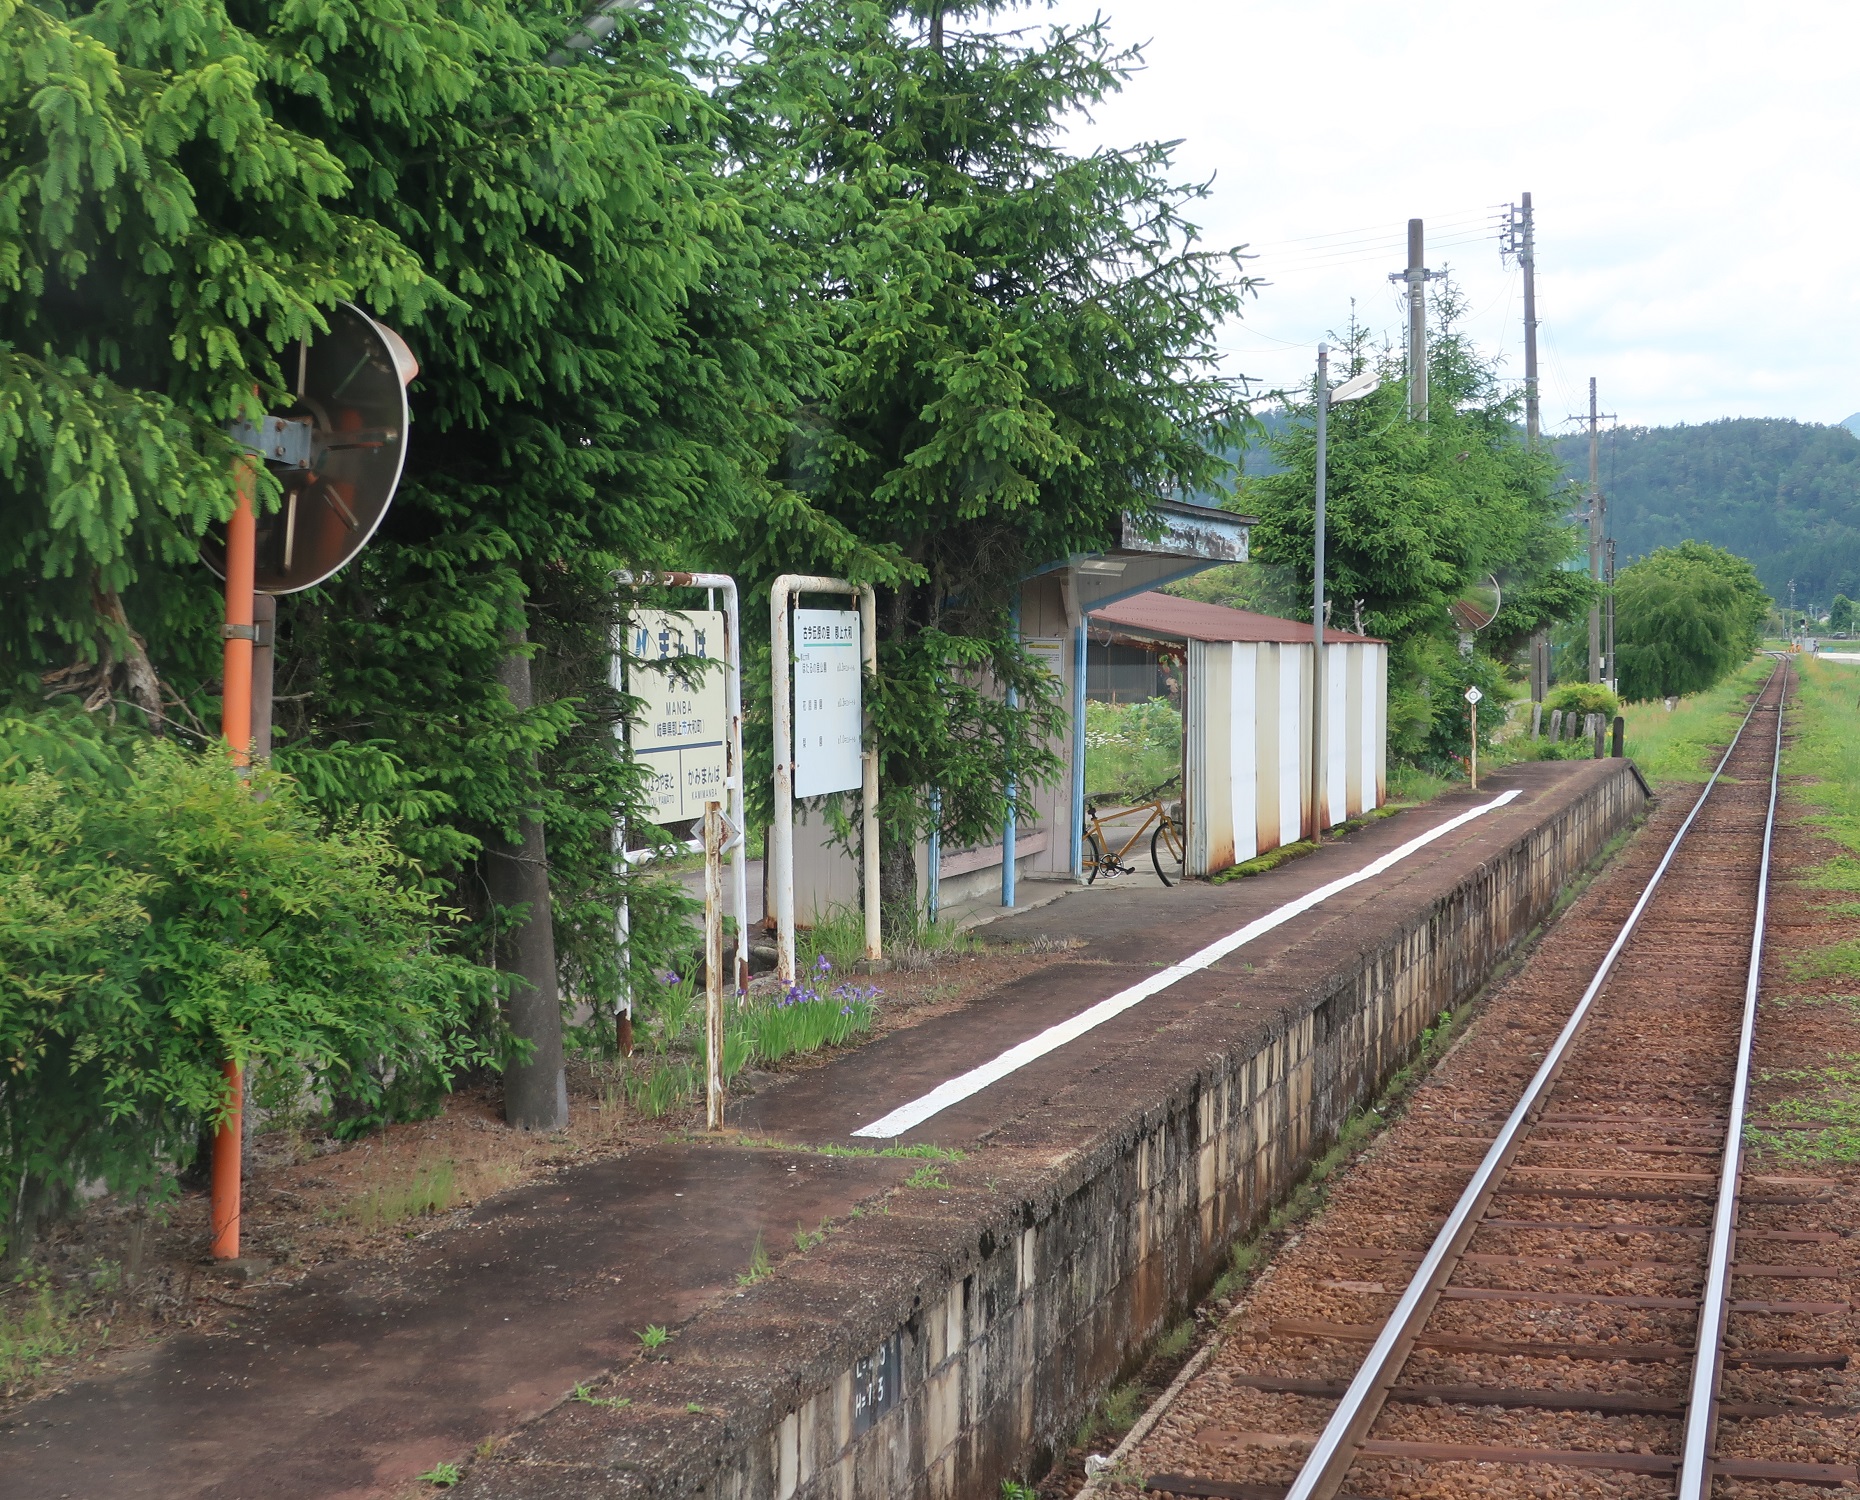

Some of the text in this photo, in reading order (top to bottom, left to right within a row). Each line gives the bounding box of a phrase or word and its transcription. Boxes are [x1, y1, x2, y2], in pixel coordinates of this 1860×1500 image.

[835, 625, 853, 639] 郡上大和
[666, 700, 692, 716] MANBA
[688, 765, 720, 785] かみまんば
[691, 788, 718, 800] KAMIMANBA
